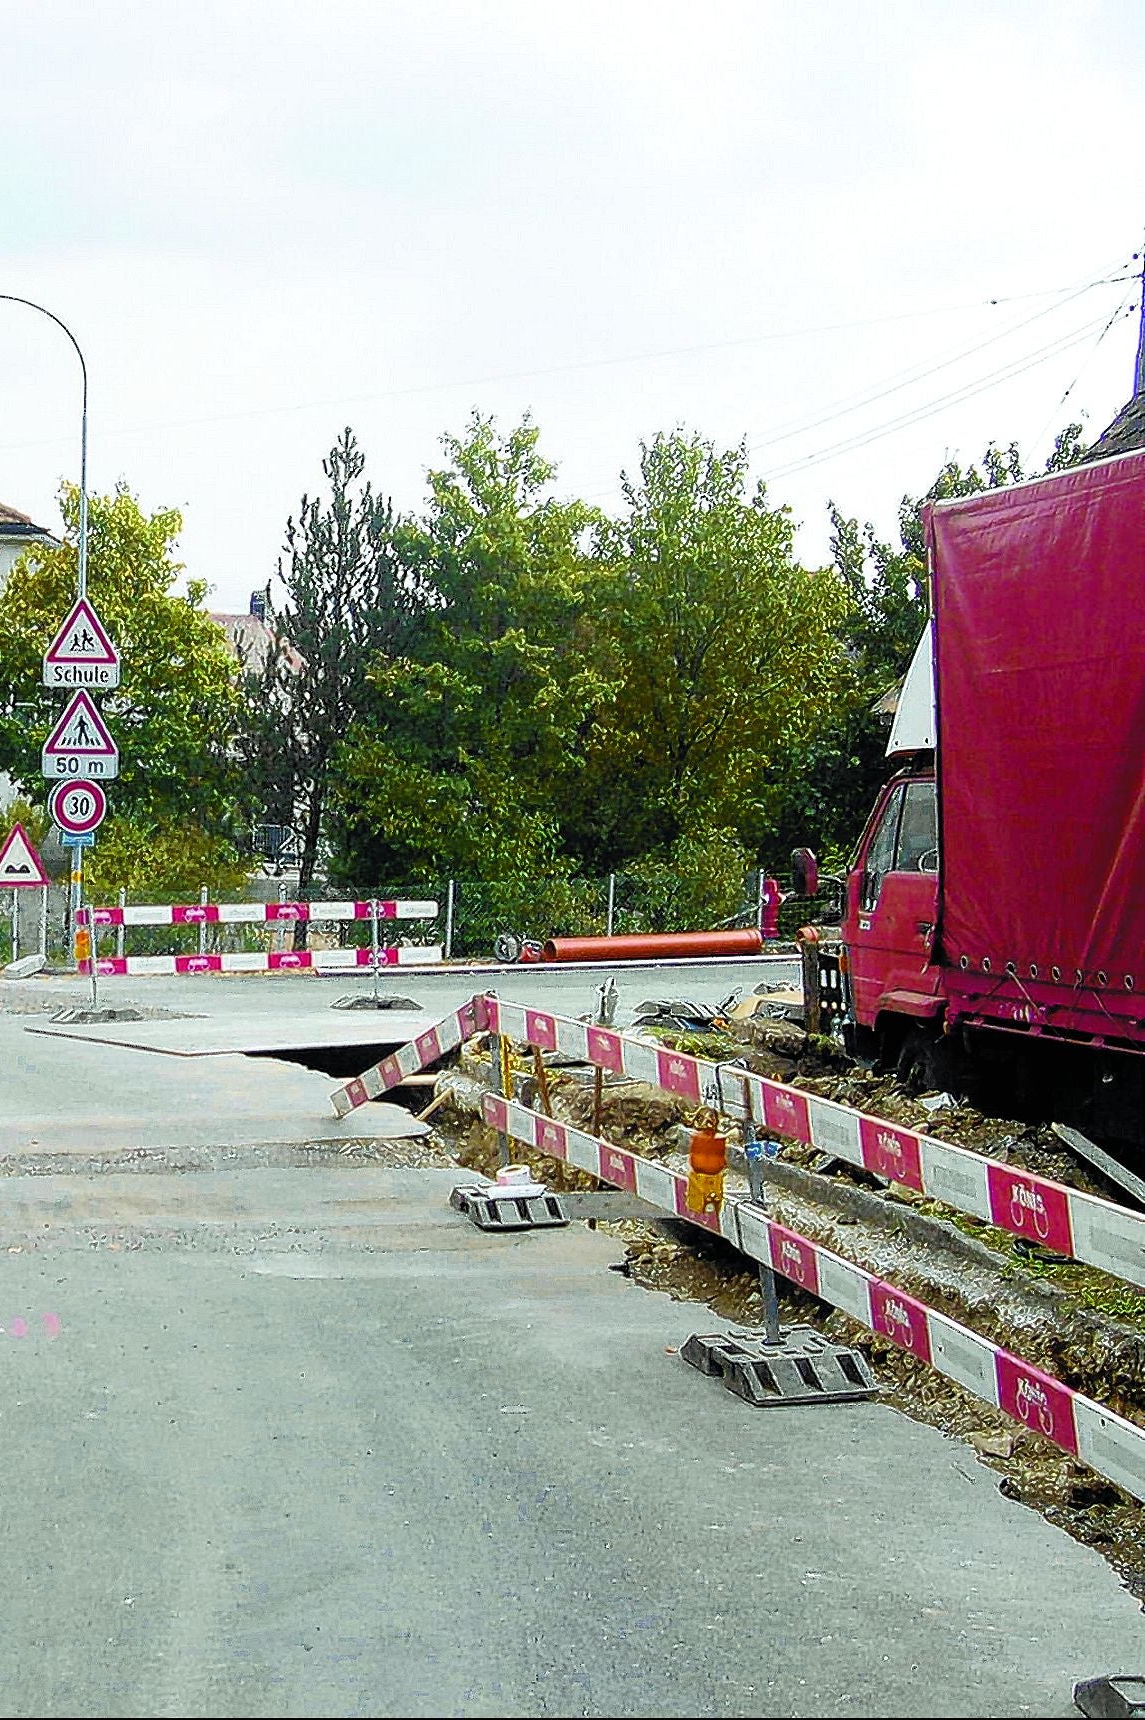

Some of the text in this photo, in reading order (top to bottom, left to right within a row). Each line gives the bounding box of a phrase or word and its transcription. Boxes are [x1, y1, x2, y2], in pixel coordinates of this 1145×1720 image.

[54, 665, 109, 683] Schule
[56, 757, 104, 774] 50 m
[69, 796, 90, 816] 30
